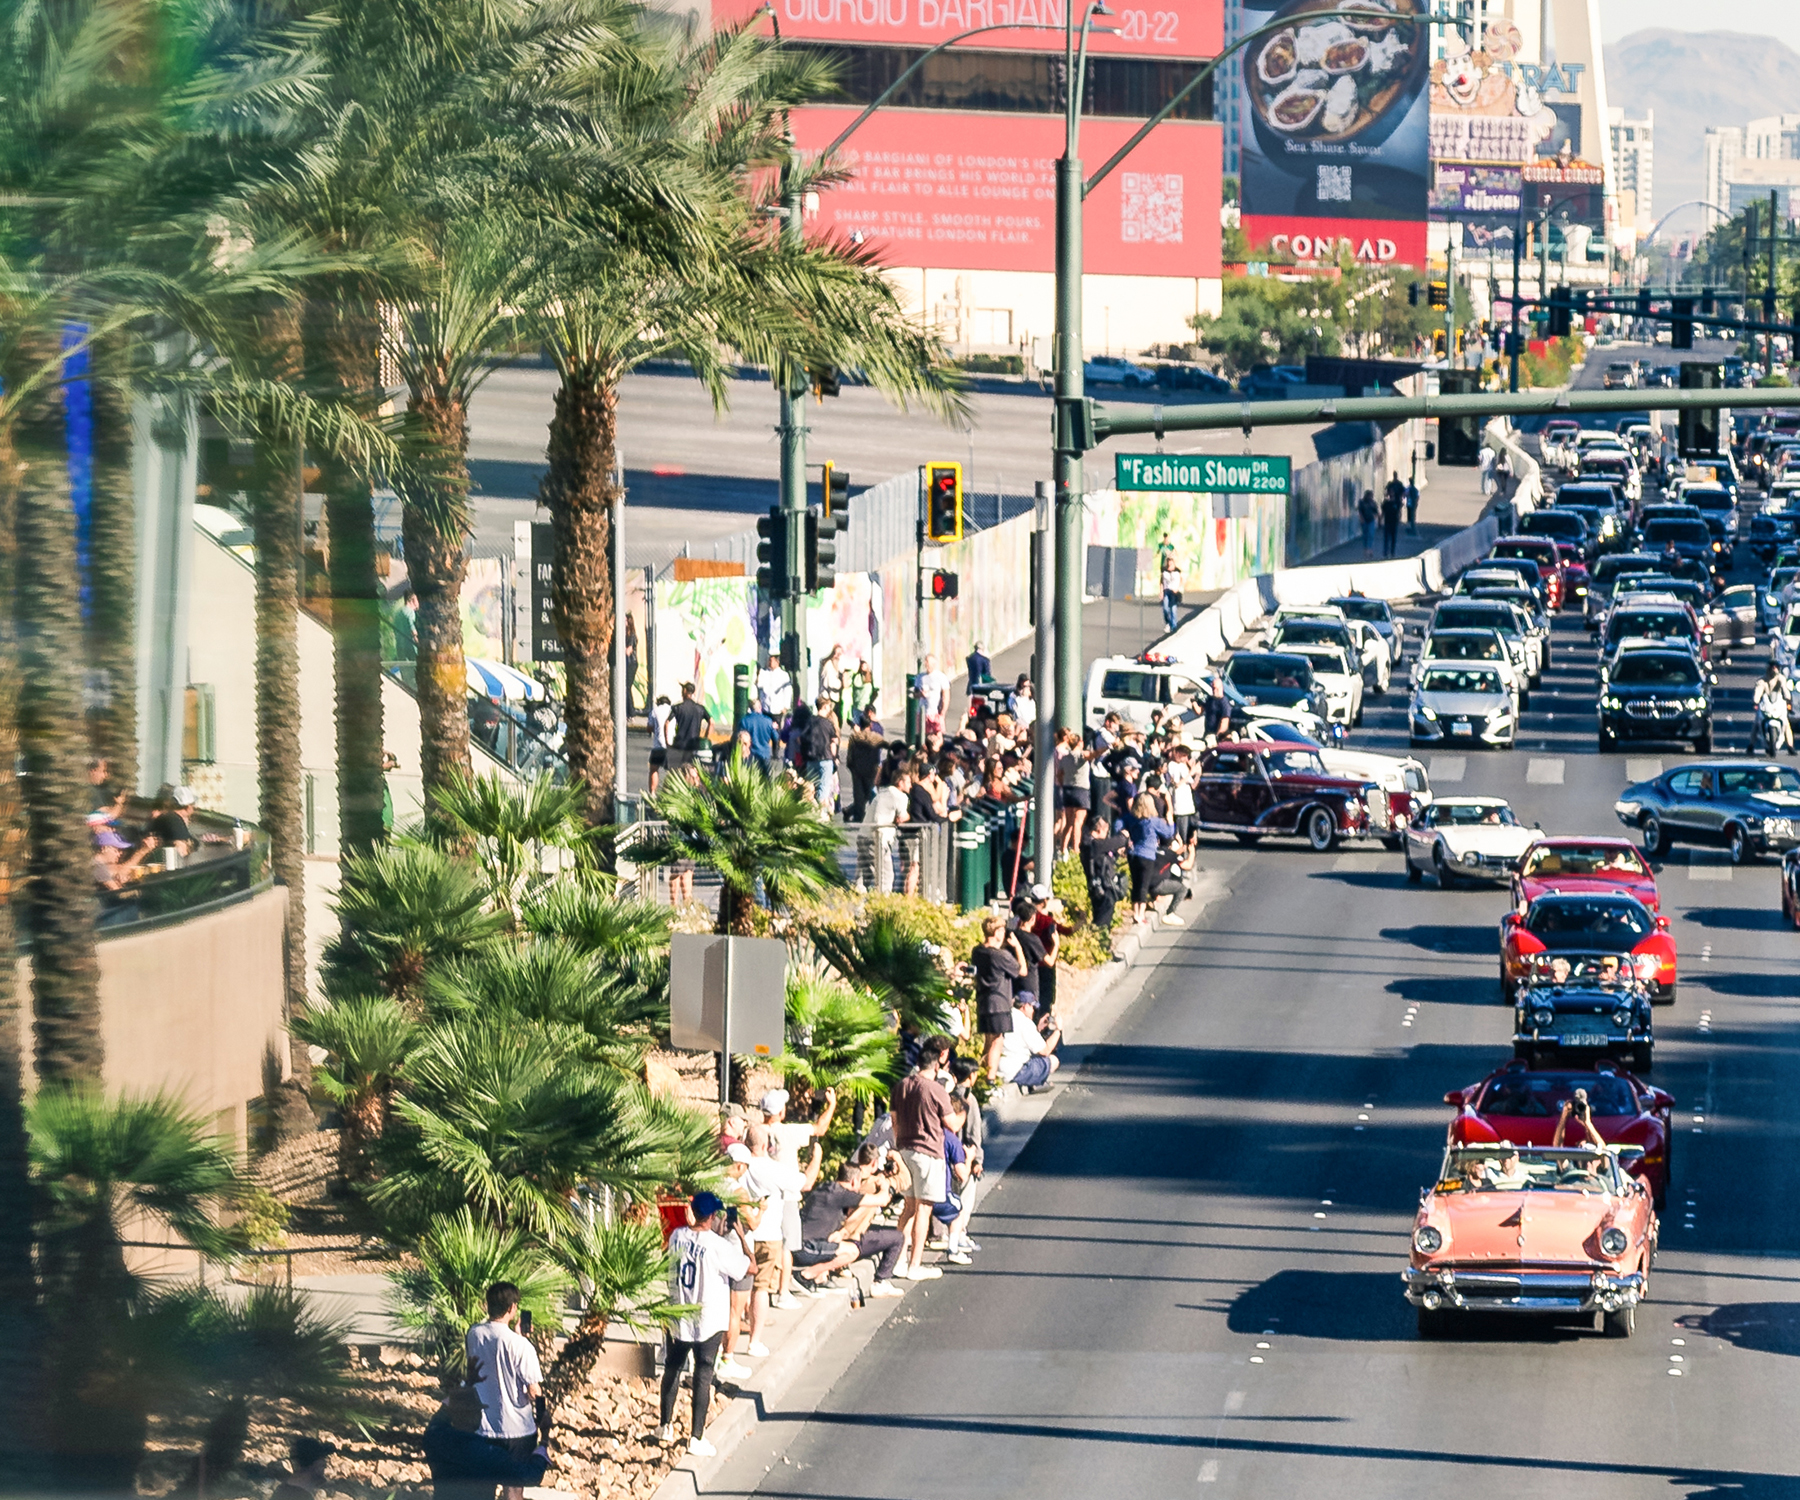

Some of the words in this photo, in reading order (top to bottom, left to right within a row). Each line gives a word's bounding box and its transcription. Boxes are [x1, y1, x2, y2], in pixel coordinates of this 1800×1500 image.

[1122, 459, 1132, 471] W
[1132, 459, 1200, 486] Fashion
[1204, 460, 1251, 487] Show
[1252, 461, 1269, 474] DR
[1252, 477, 1286, 490] 2200
